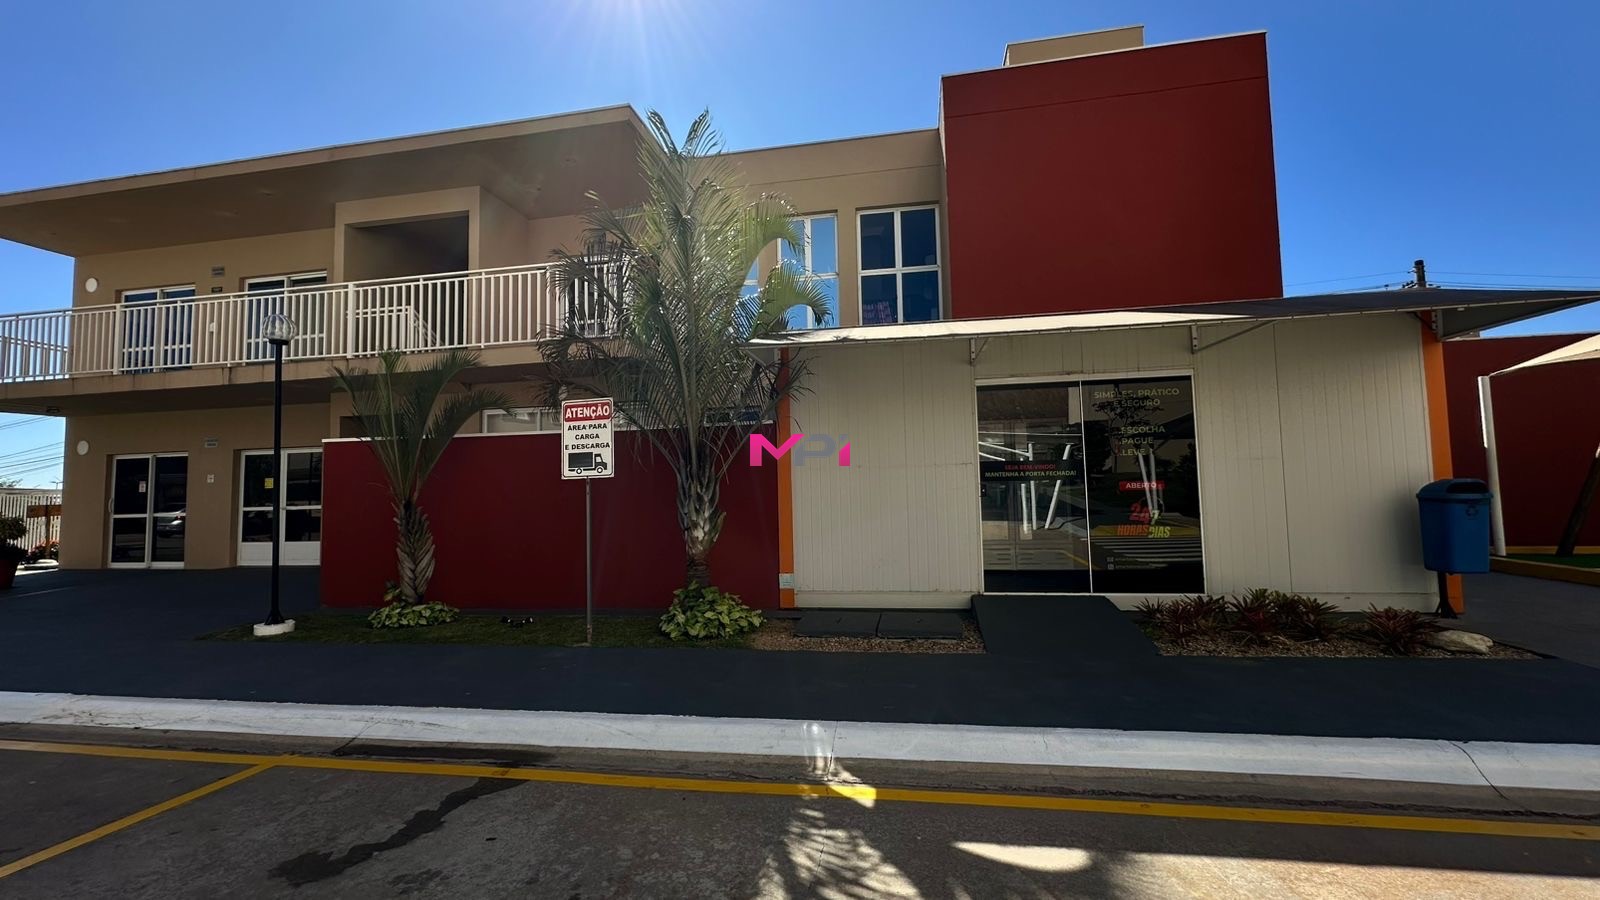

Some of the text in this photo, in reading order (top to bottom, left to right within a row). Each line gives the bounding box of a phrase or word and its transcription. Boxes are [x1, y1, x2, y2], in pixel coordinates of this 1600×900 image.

[1121, 398, 1161, 407] SEGURO
[565, 404, 610, 419] ATENÇÃO
[571, 442, 610, 450] DESCARGA
[1117, 524, 1149, 537] HORAS
